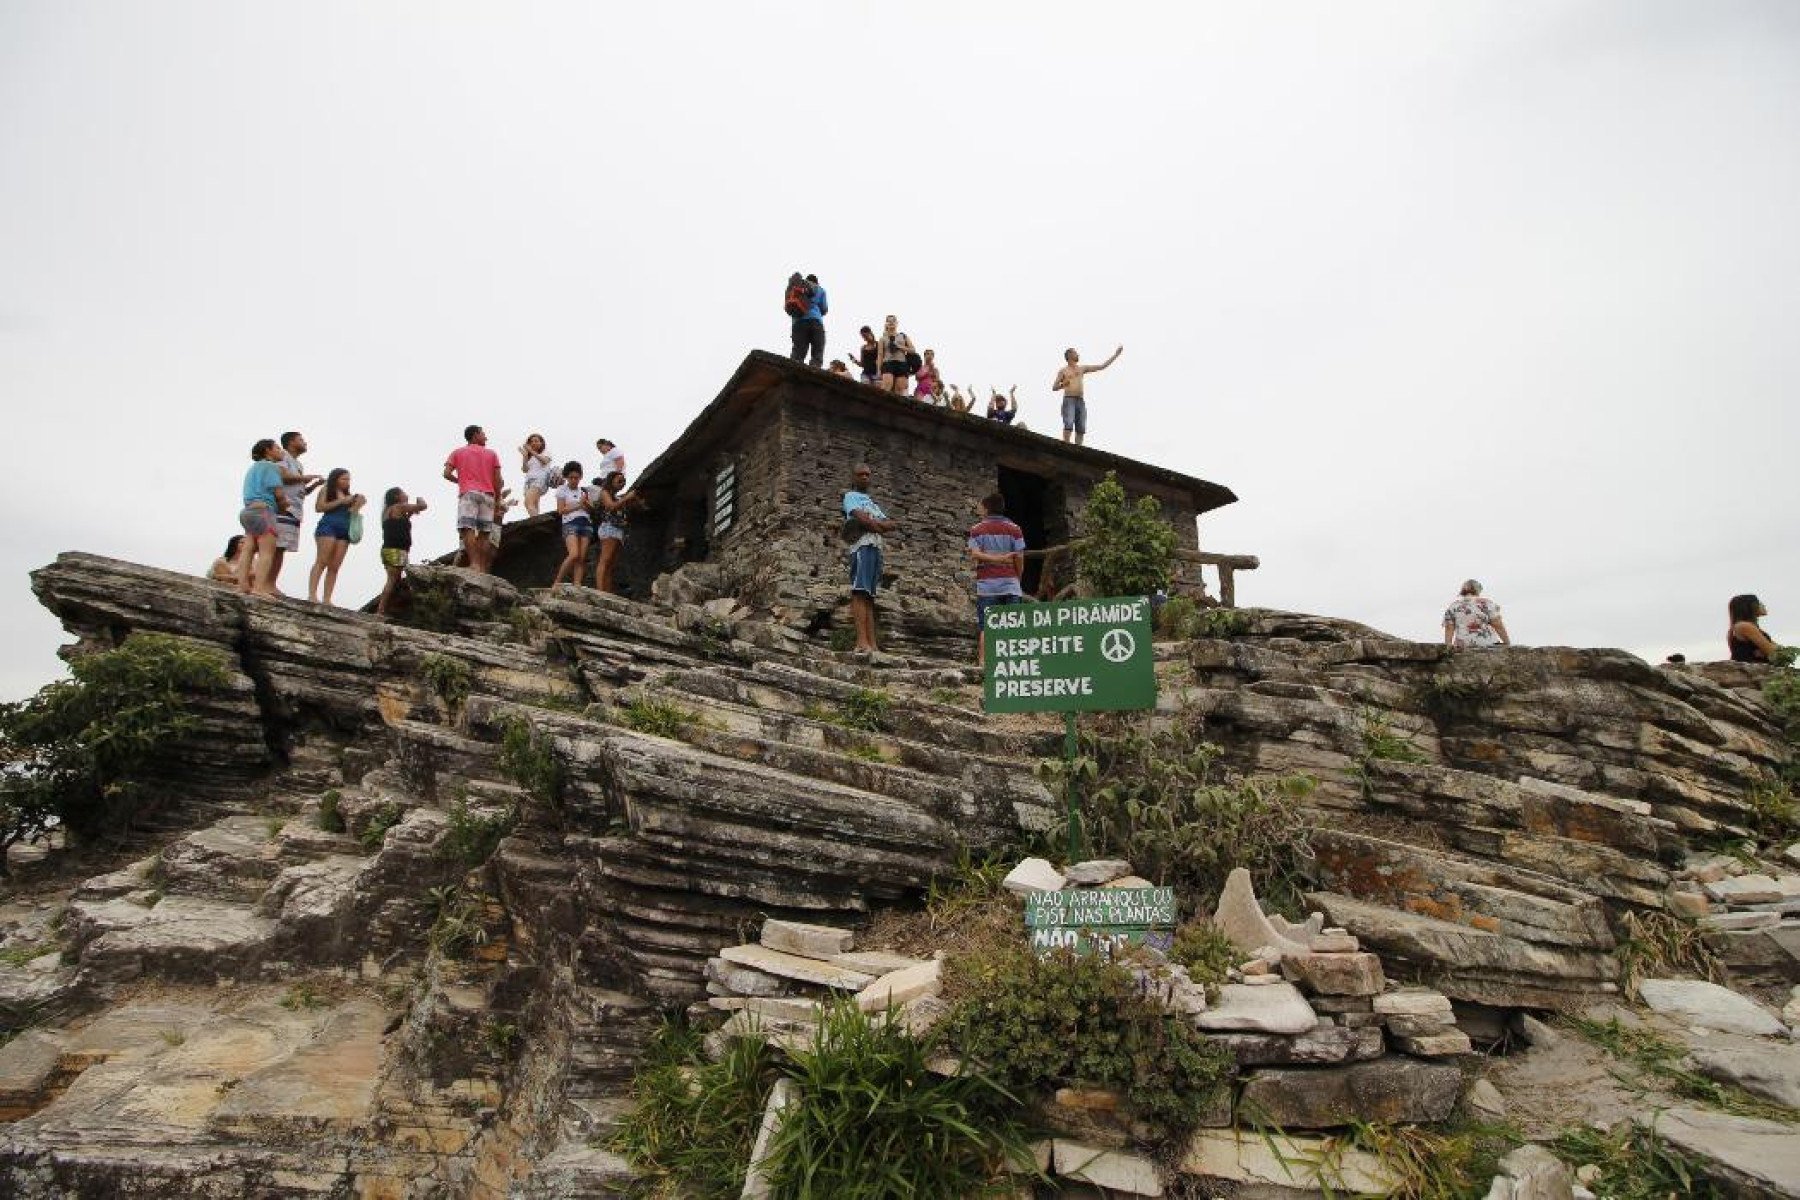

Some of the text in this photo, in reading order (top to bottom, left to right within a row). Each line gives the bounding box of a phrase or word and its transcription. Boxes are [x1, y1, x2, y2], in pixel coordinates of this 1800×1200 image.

[1033, 609, 1052, 627] DA
[993, 659, 1041, 678] AME
[995, 676, 1093, 698] PRESERVE
[1070, 890, 1148, 908] ARRANQUE
[1153, 889, 1172, 906] OU
[1035, 906, 1172, 925] PISE NAS PLANTAS
